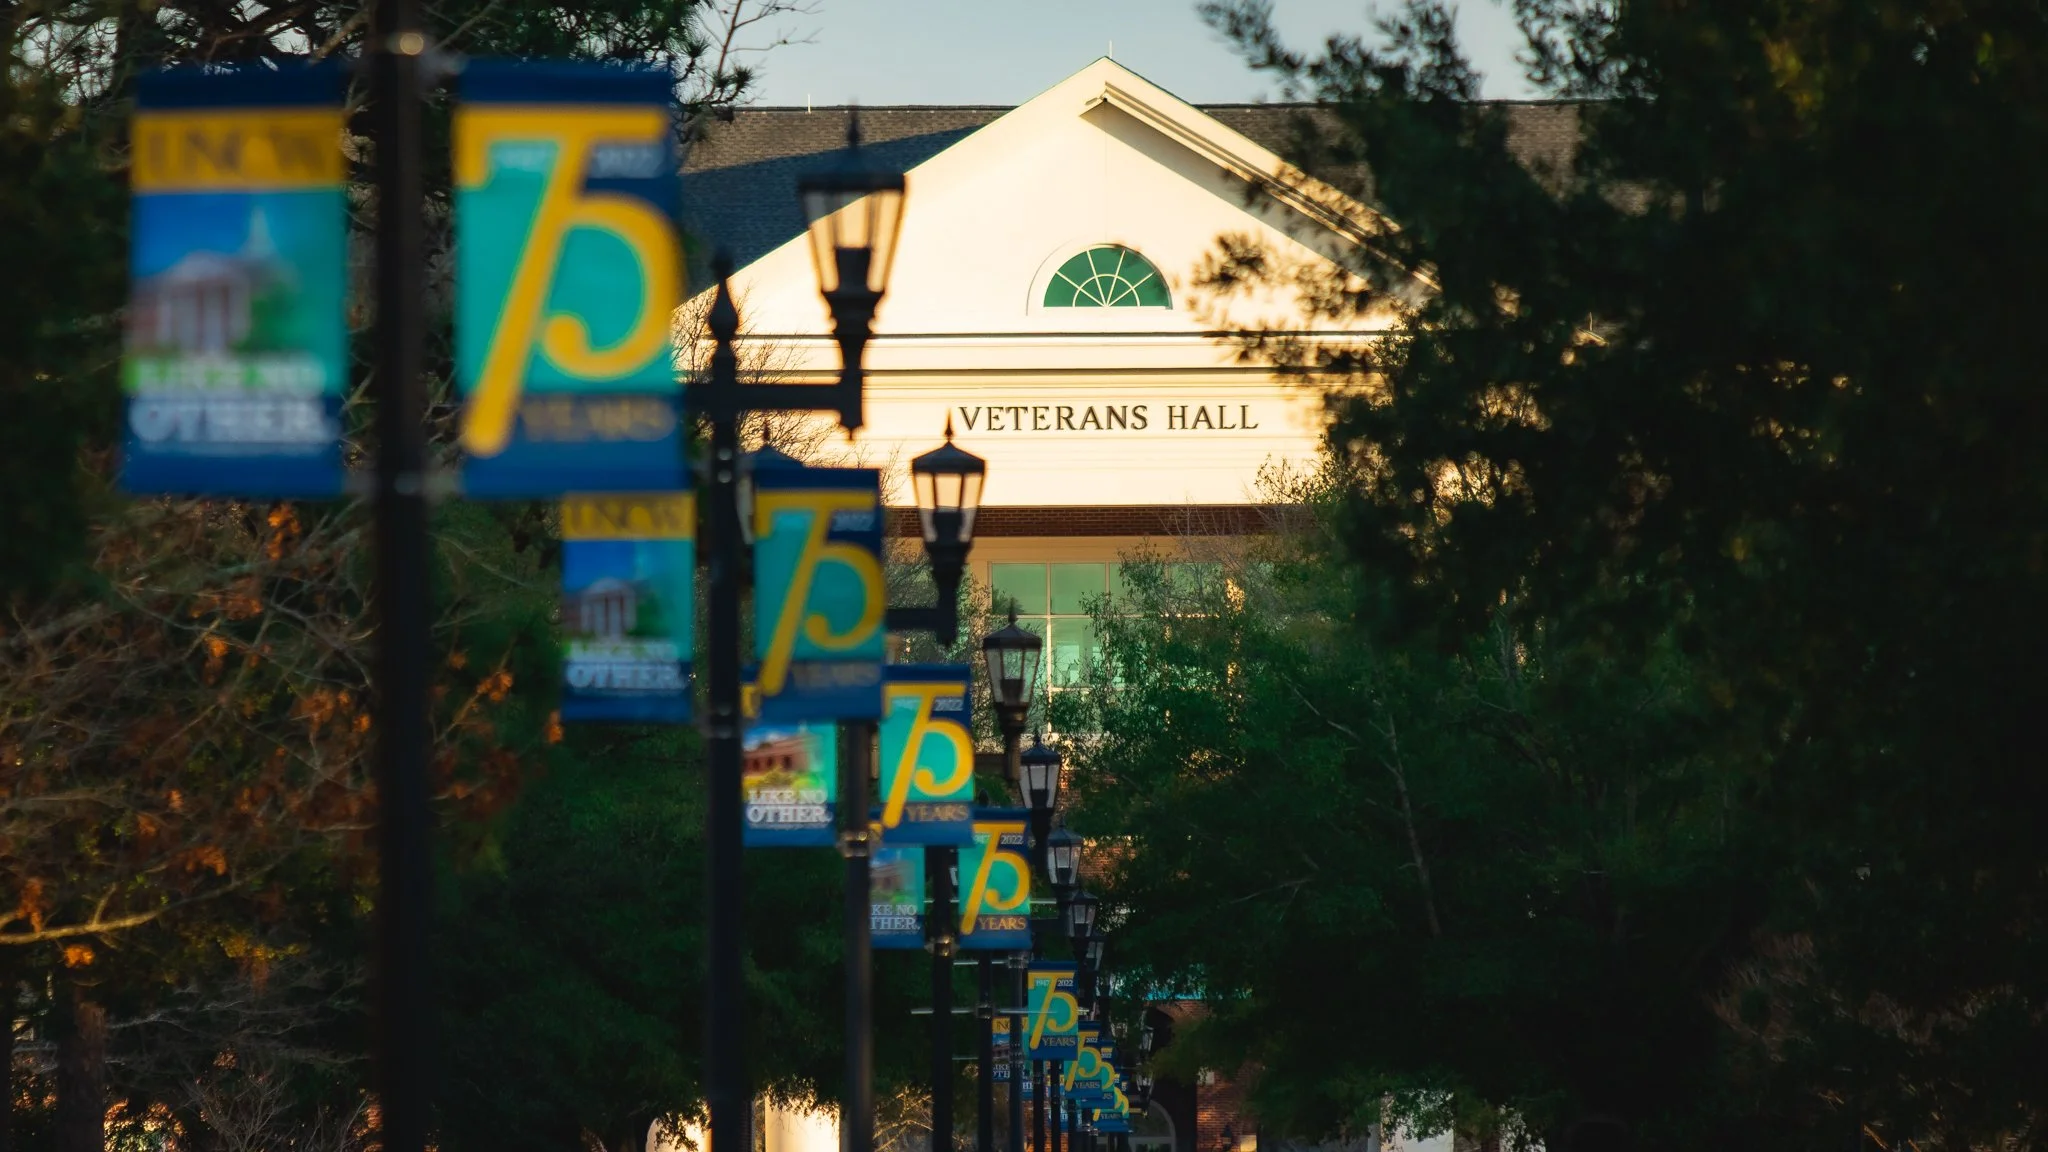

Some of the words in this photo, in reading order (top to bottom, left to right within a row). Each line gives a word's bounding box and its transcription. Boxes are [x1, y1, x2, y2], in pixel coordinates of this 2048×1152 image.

[453, 106, 688, 455] 75
[960, 406, 1148, 431] VETERANS
[1168, 405, 1259, 430] HALL
[754, 489, 886, 695] 75
[883, 682, 974, 829] 75
[748, 789, 794, 805] LIKE
[799, 789, 827, 805] NO
[747, 805, 832, 823] OTHER.
[905, 804, 969, 822] YEARS
[1001, 834, 1024, 845] 2022
[960, 821, 1031, 935] 75
[896, 904, 918, 916] NO
[870, 917, 921, 930] THER.
[979, 917, 1027, 930] YEARS
[1057, 979, 1073, 987] 2022
[1028, 971, 1078, 1050] 75
[1042, 1037, 1076, 1047] YEARS
